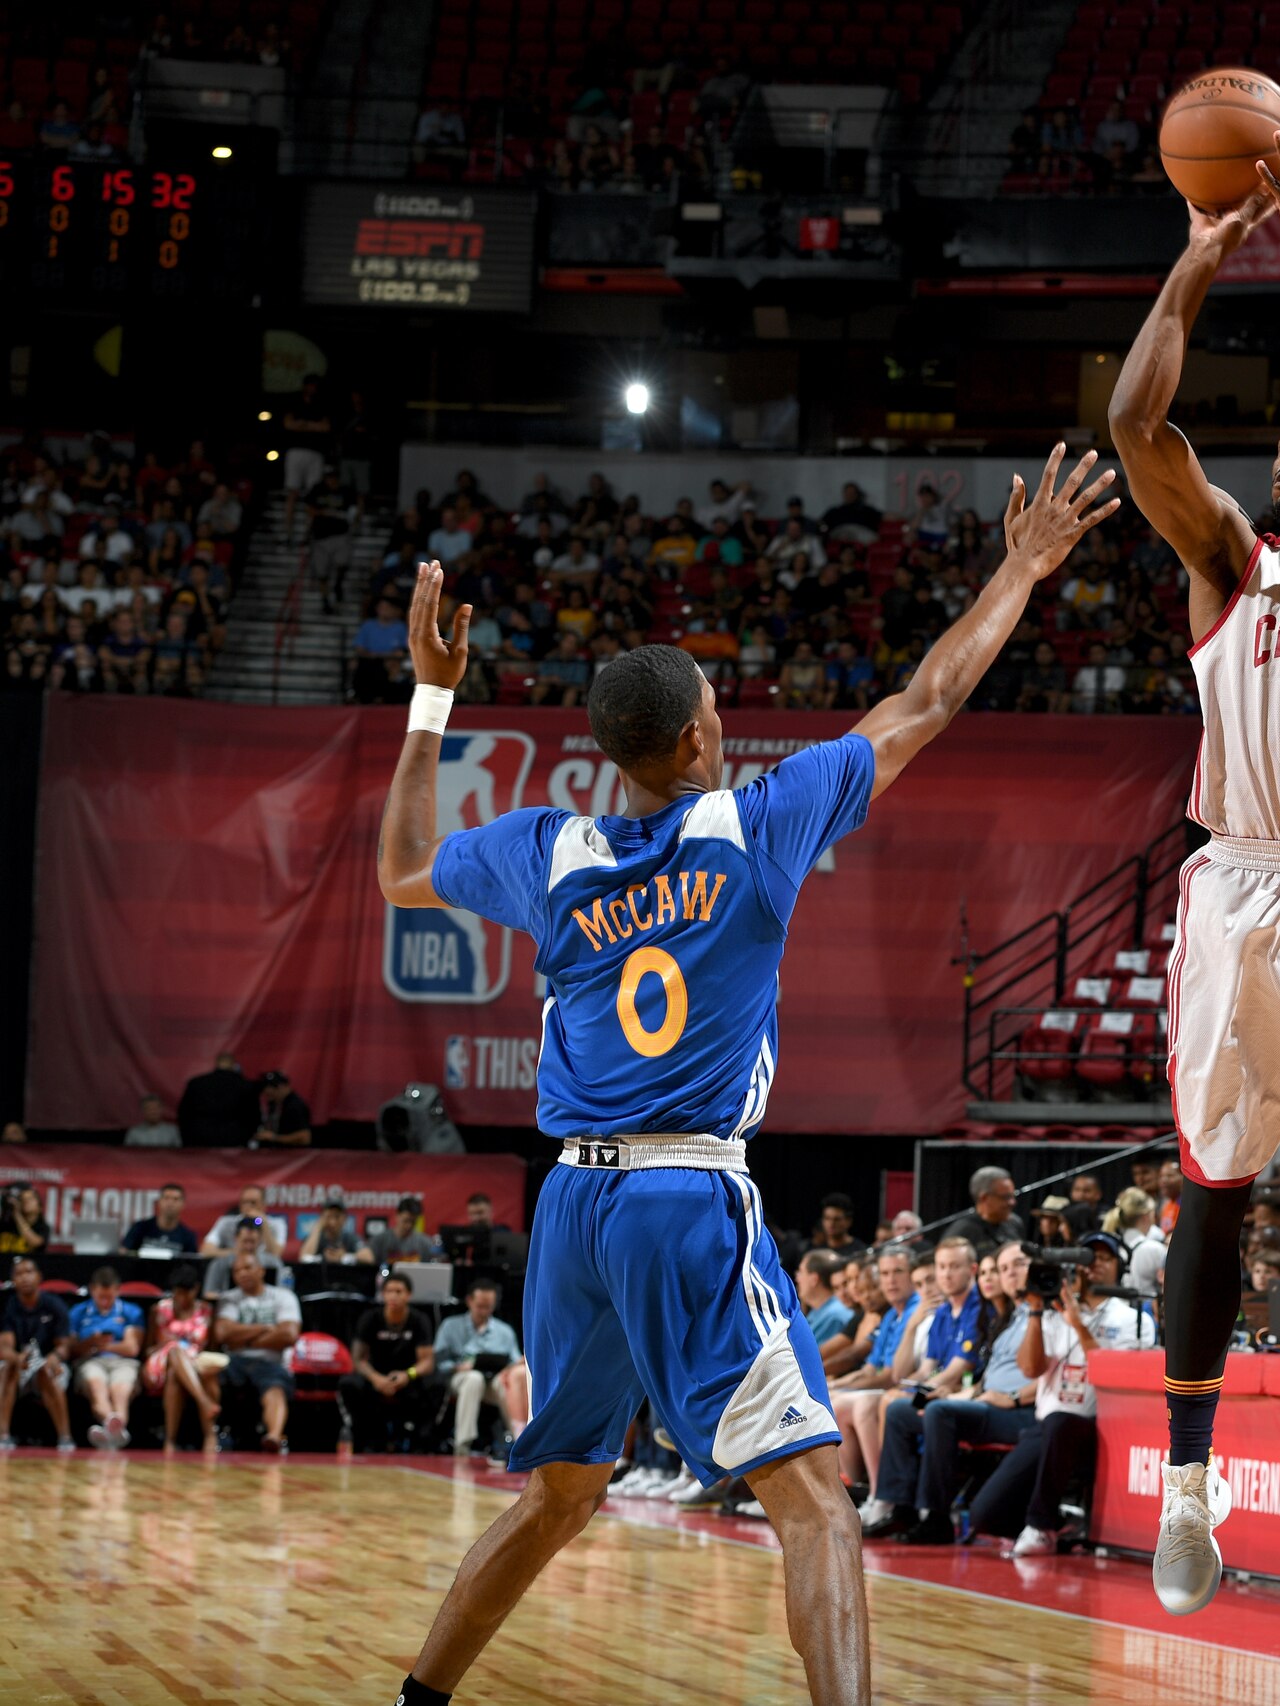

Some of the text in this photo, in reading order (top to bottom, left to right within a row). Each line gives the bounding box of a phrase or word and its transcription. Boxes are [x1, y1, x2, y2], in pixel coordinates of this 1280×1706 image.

[52, 164, 76, 201] 6
[102, 168, 136, 206] 15
[151, 171, 197, 210] 32
[51, 204, 190, 240] 0 0 0
[355, 218, 485, 260] ESPN
[159, 240, 179, 269] 0
[571, 871, 728, 952] McCAW
[401, 931, 460, 980] NBA
[617, 946, 689, 1058] 0
[474, 1036, 538, 1090] THIS
[779, 1415, 808, 1429] adidas
